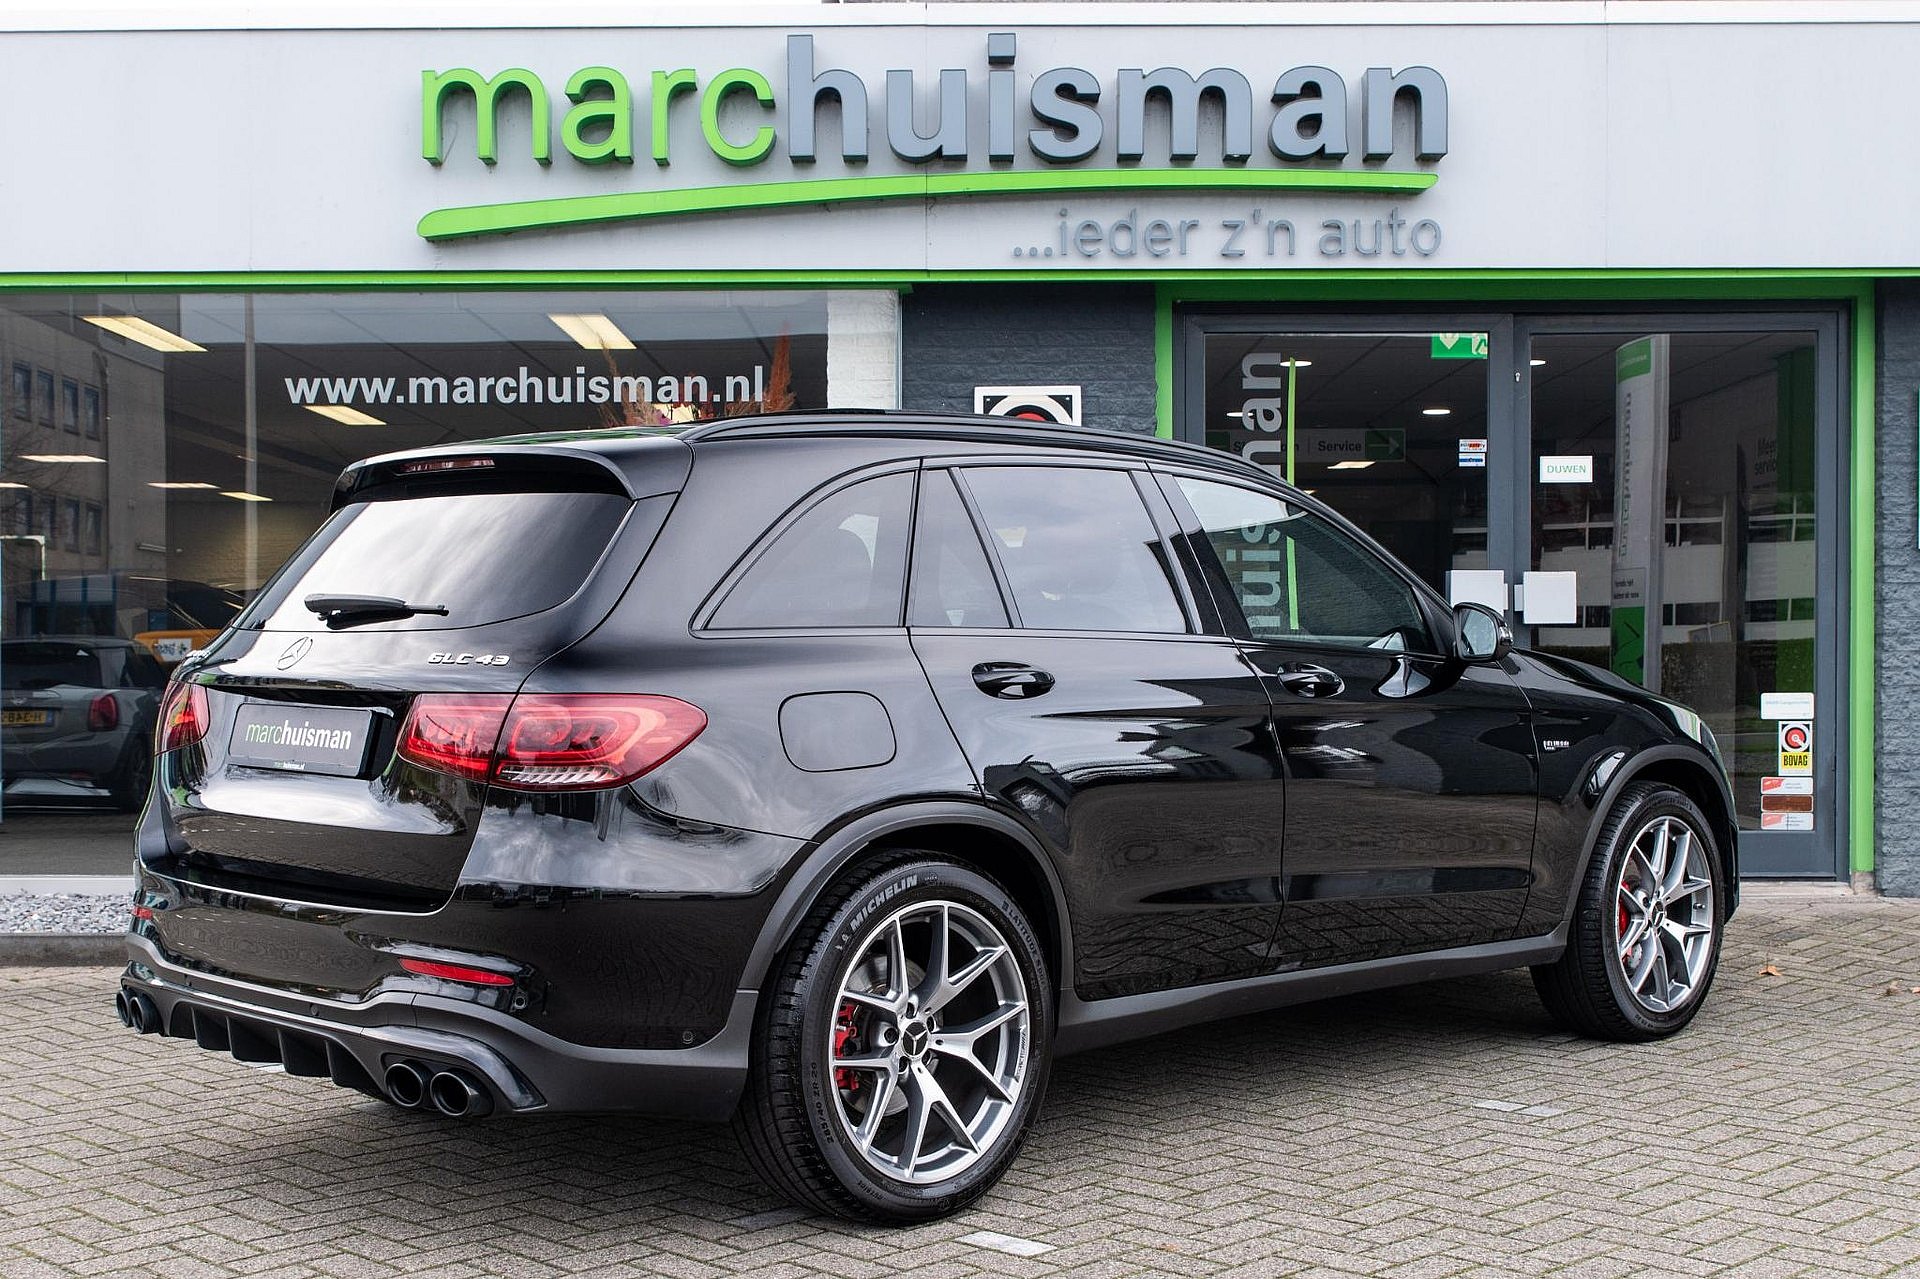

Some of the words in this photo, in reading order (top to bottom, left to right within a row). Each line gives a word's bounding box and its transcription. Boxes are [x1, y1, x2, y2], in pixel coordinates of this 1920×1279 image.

[421, 33, 1449, 167] marchuisman
[1219, 207, 1297, 258] z'n
[1317, 206, 1443, 258] auto
[284, 366, 765, 405] www.marchuisman.nl
[1317, 439, 1362, 453] Service
[1546, 464, 1587, 474] DUWEN
[427, 652, 474, 665] GLC
[475, 654, 511, 667] 43
[244, 719, 352, 750] marchuisman
[1783, 753, 1808, 766] BOVAG
[850, 874, 918, 932] MICHELIN
